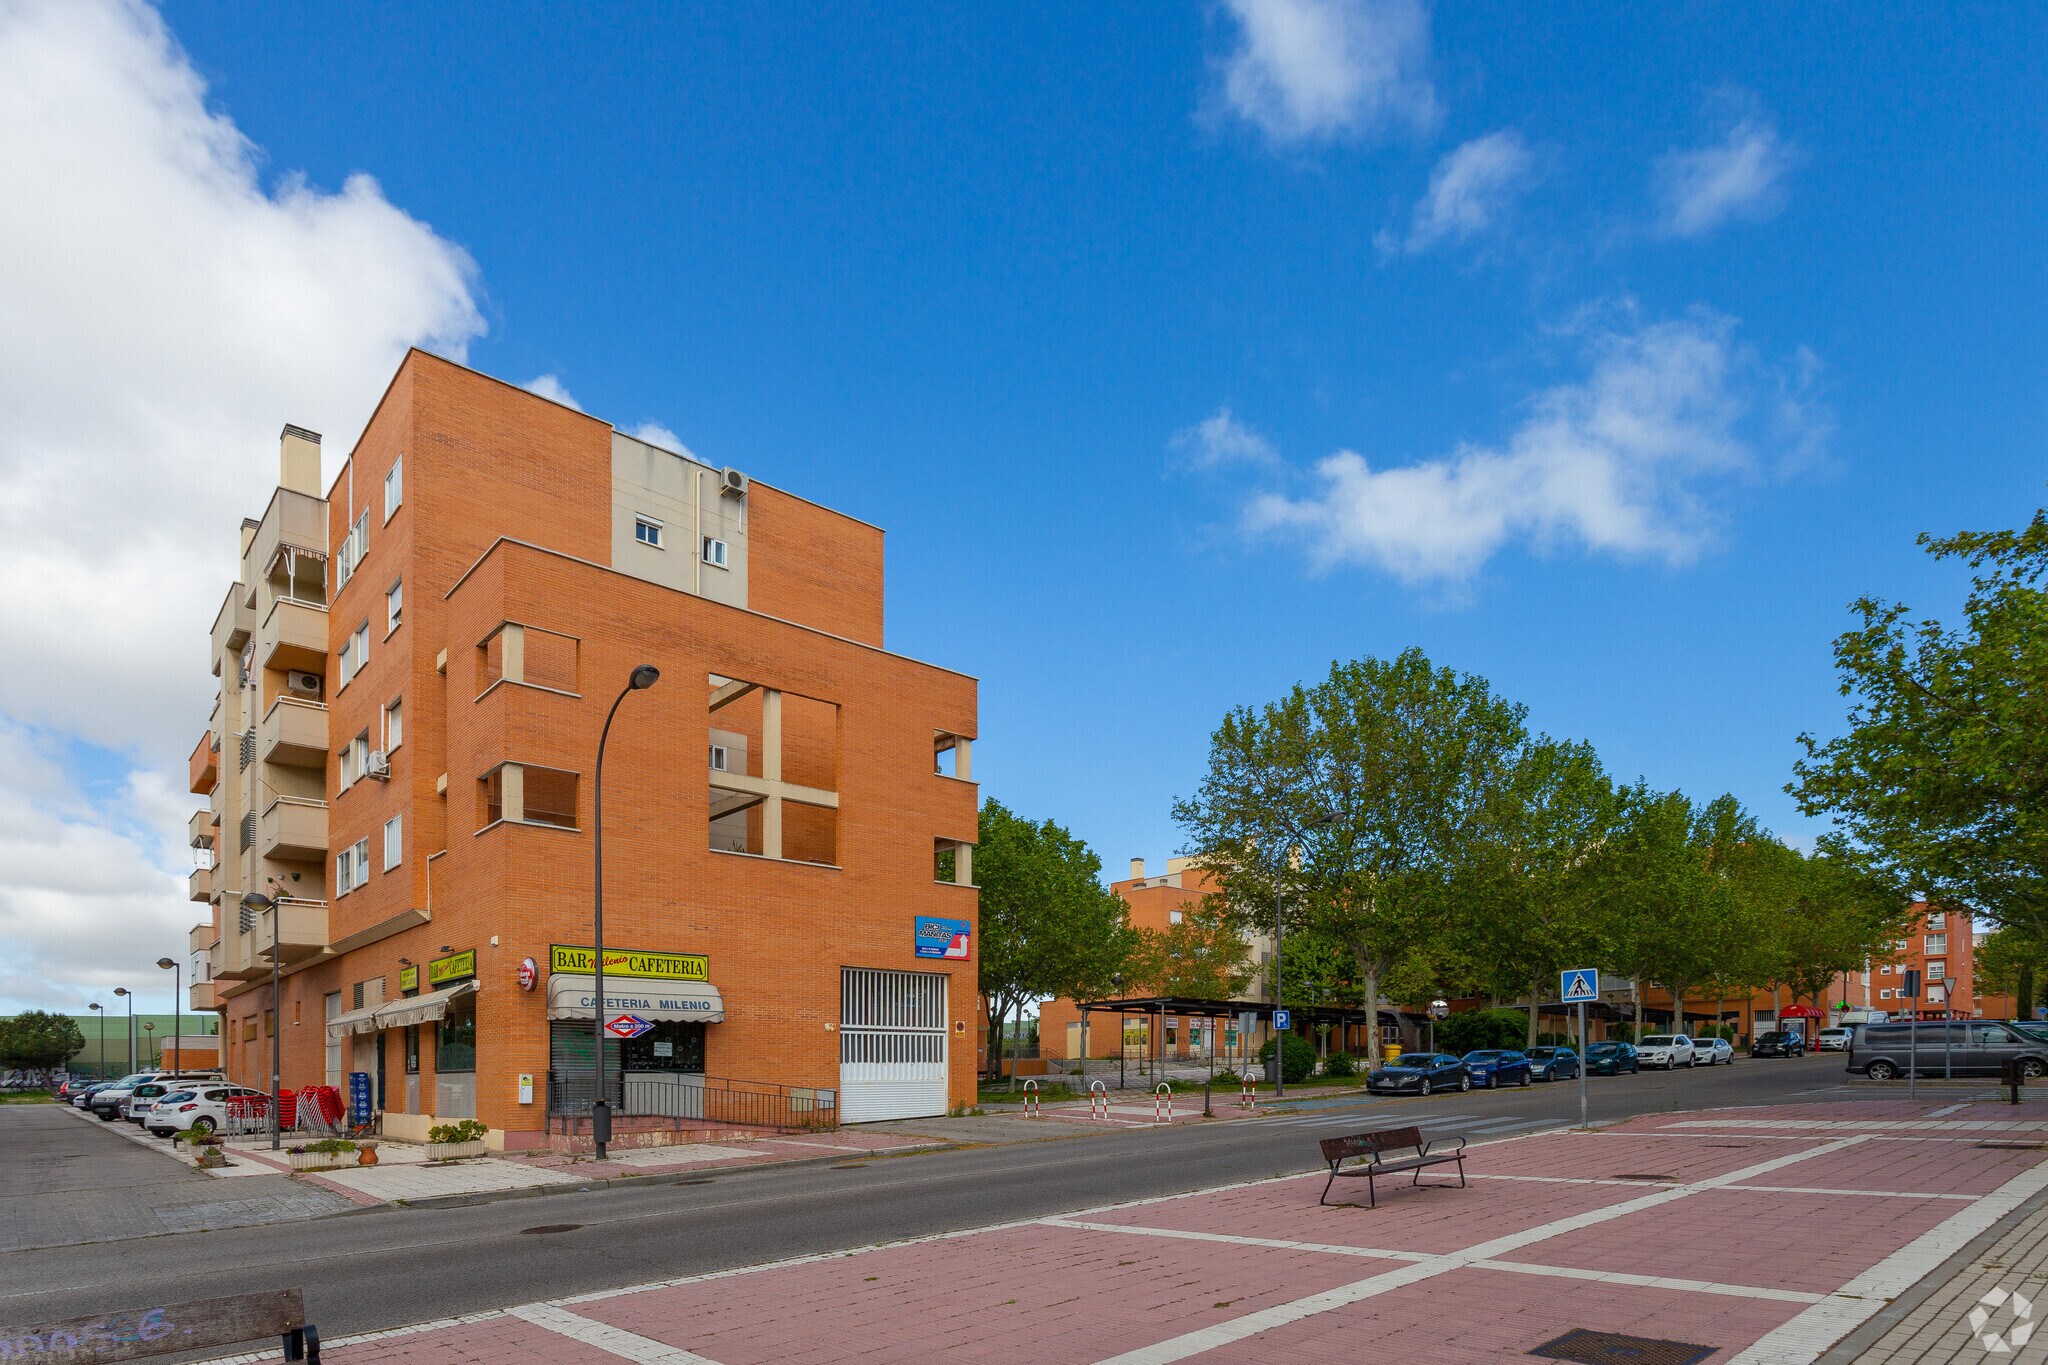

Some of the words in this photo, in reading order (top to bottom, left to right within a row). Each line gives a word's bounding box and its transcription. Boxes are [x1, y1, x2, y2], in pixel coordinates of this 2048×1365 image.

[918, 930, 952, 939] MANITAS
[557, 951, 587, 968] BAR
[588, 955, 628, 969] Mlenio
[629, 956, 703, 975] CAFETERIA
[659, 1000, 711, 1011] MILENIO
[1276, 1013, 1287, 1027] P
